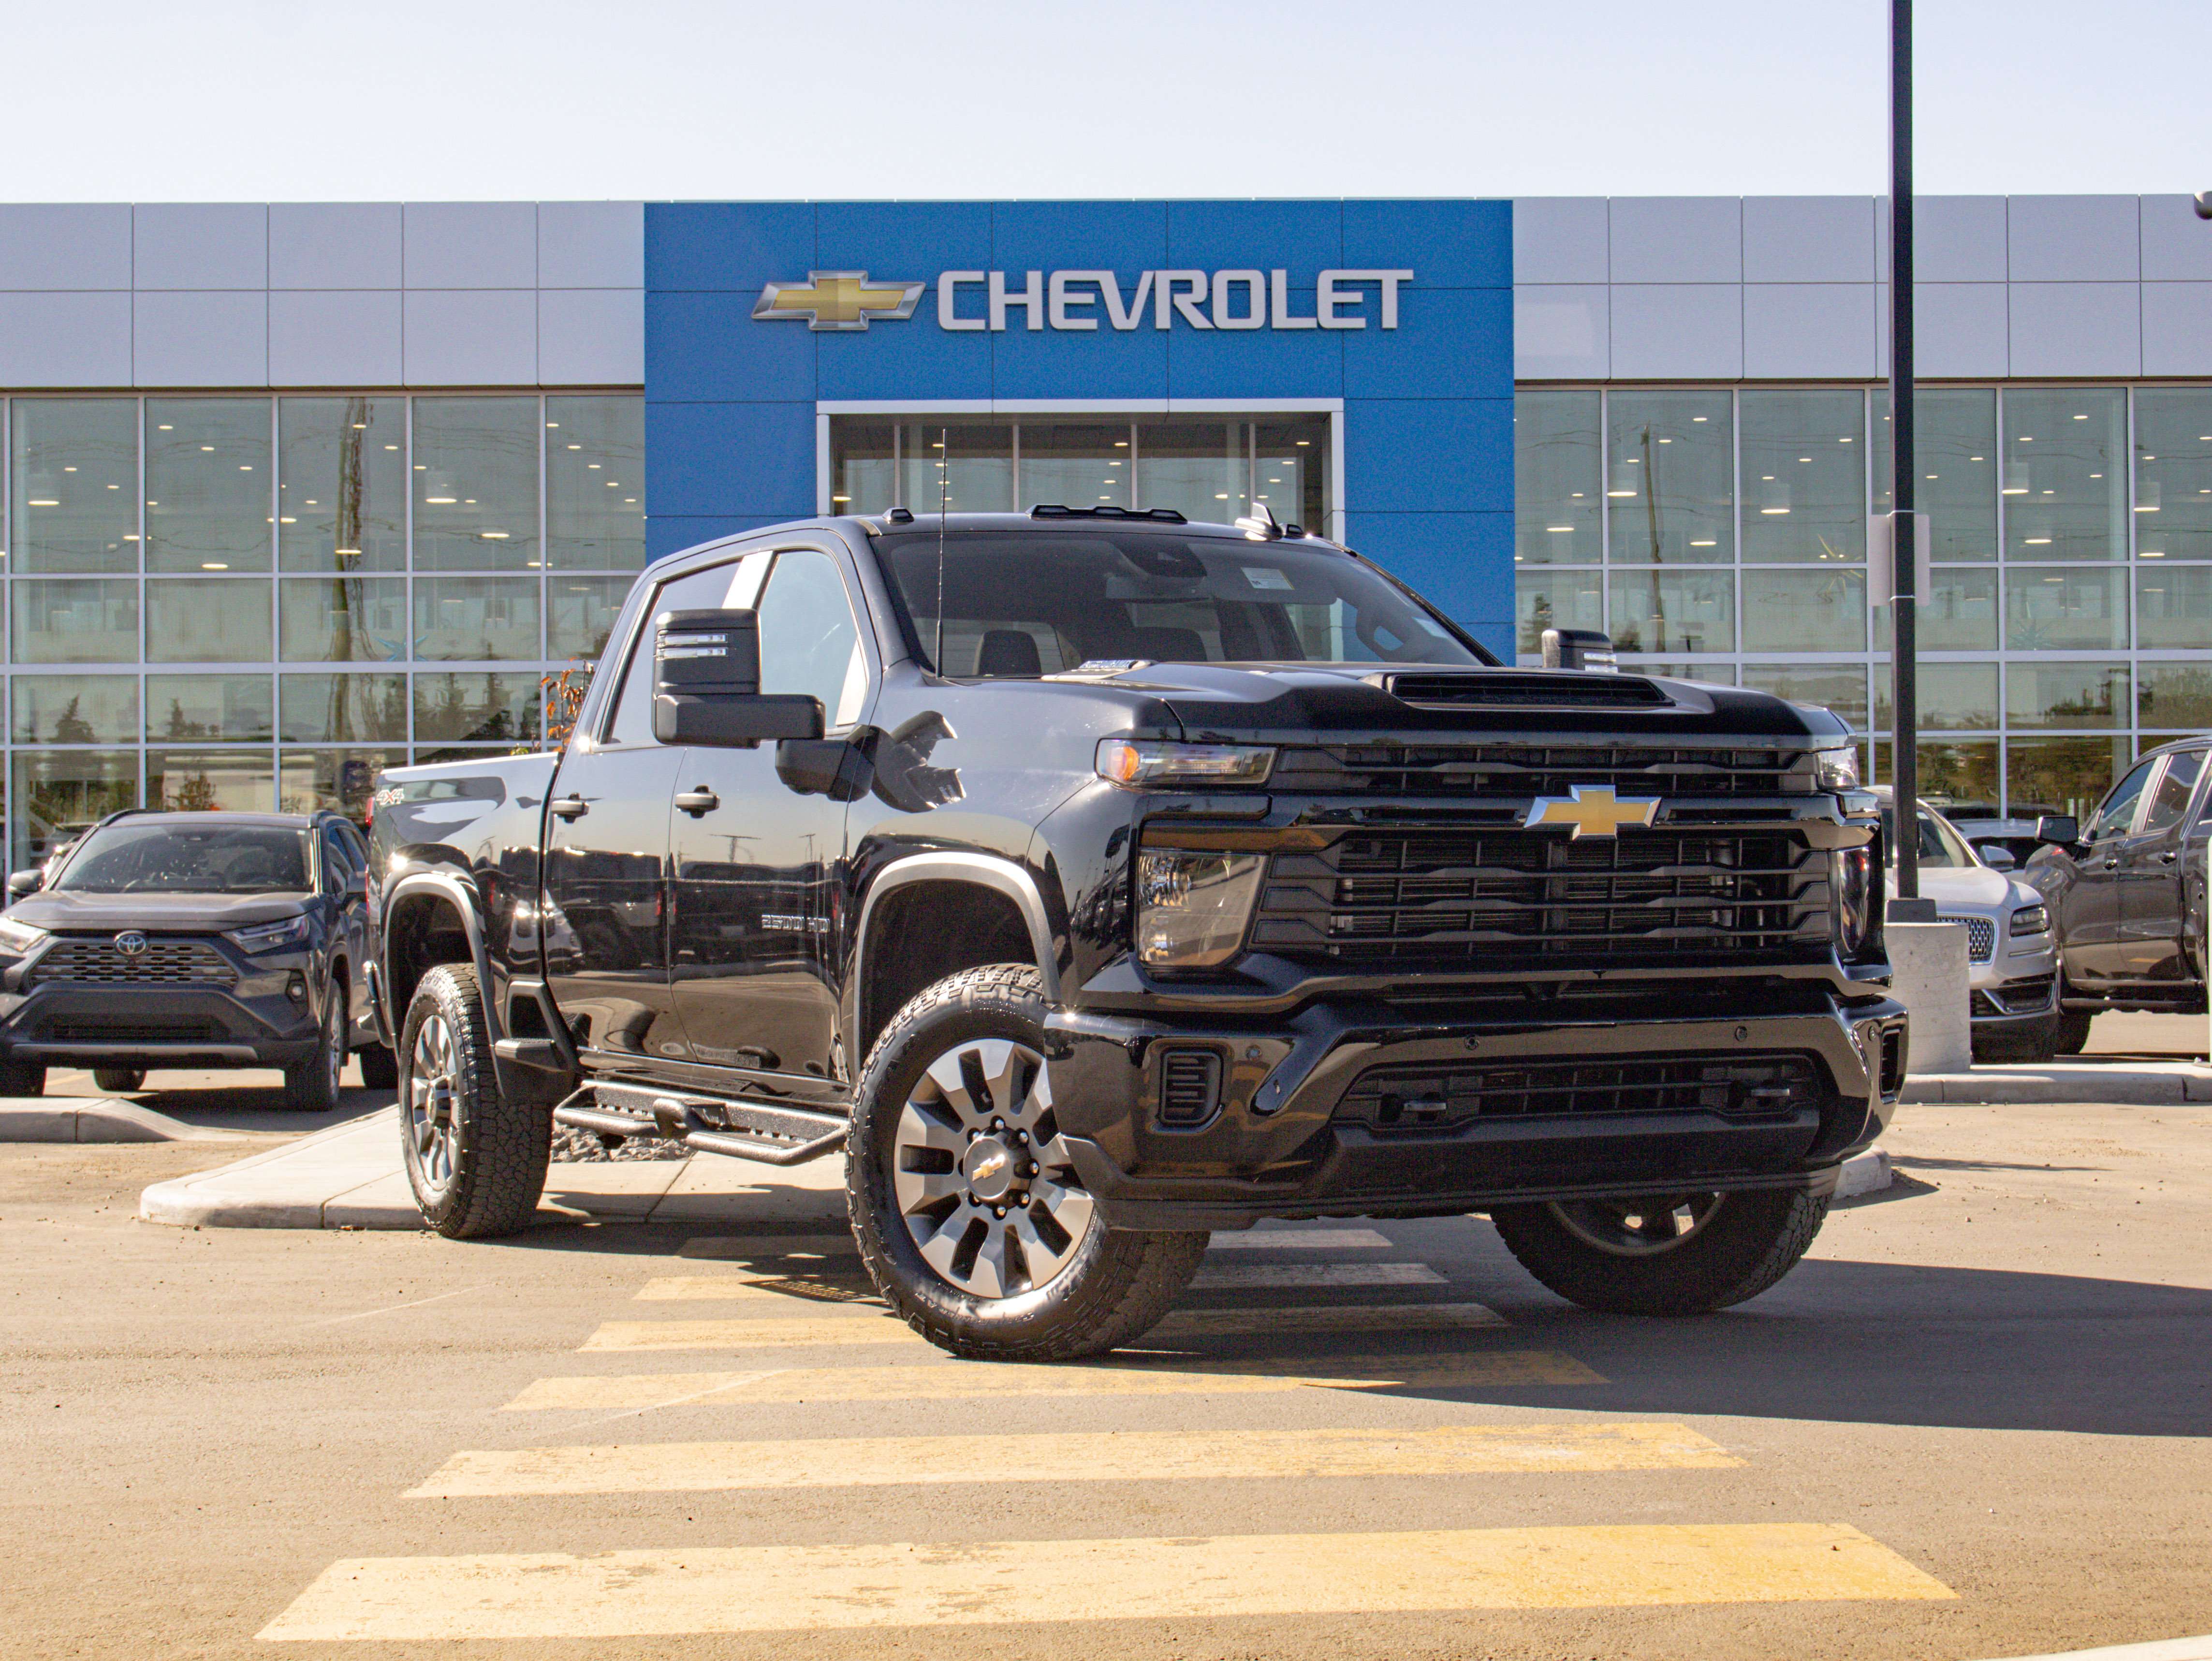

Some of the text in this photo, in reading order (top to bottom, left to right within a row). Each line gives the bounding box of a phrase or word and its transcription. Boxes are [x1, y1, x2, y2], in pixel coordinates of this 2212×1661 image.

[937, 268, 1414, 331] CHEVROLET
[762, 914, 830, 933] 2500 HD
